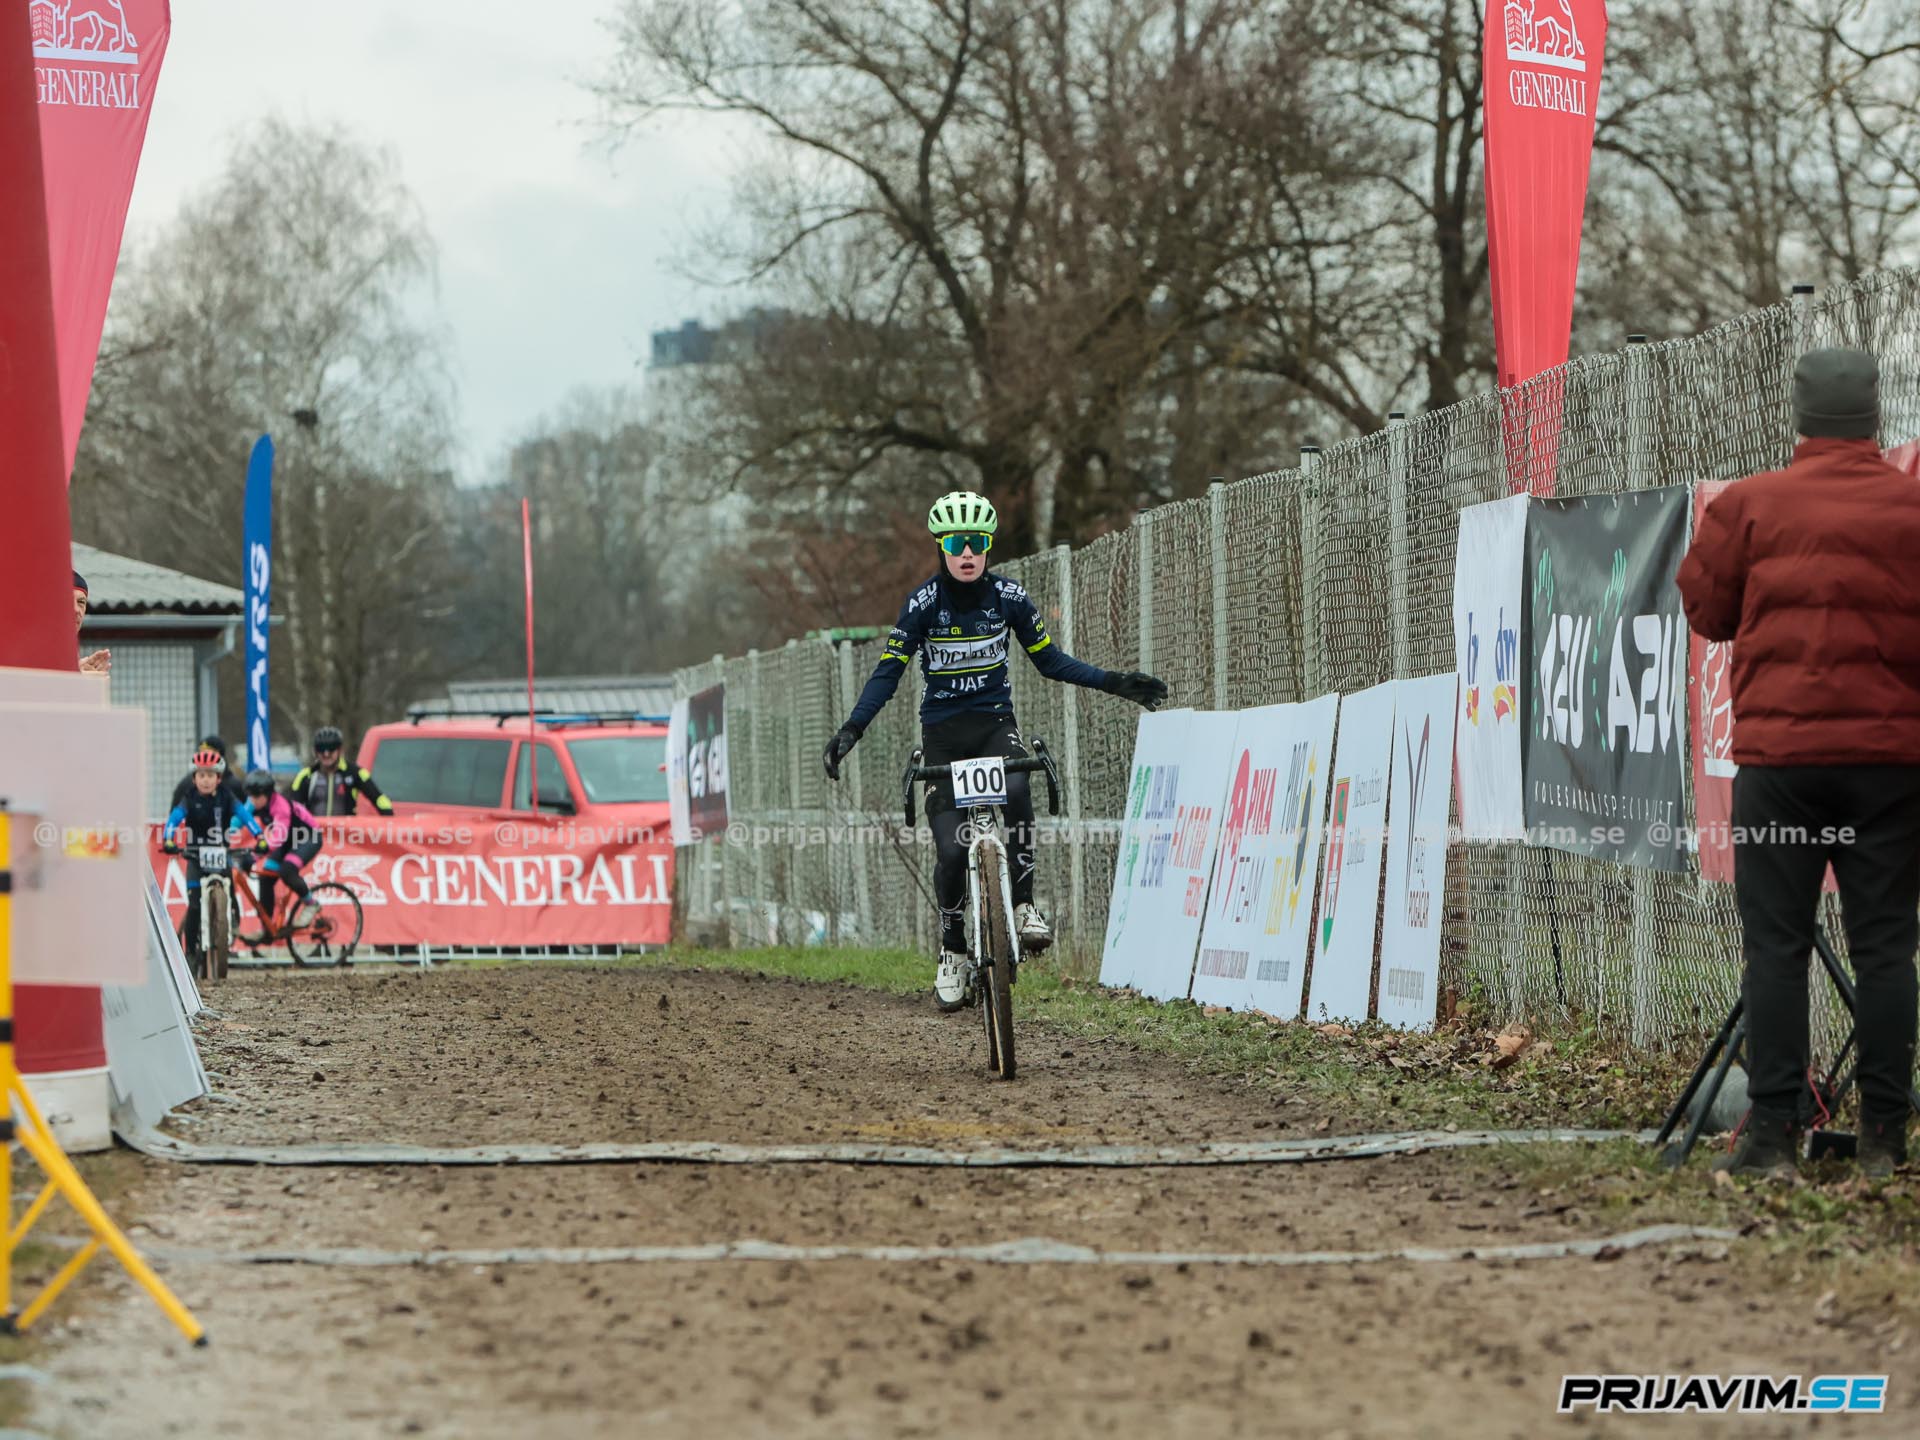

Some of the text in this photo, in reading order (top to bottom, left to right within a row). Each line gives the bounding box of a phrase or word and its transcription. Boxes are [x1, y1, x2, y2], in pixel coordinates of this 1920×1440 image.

[34, 67, 140, 109] GENERALI
[1509, 69, 1587, 116] GENERALI
[908, 581, 938, 613] A2U
[994, 580, 1027, 597] A2U
[1000, 592, 1025, 603] BIKES
[251, 541, 270, 772] DARS
[1540, 613, 1593, 749] A2U
[1607, 613, 1681, 755] A2U
[957, 767, 1004, 795] 100
[1245, 767, 1277, 835] PIKA
[390, 853, 672, 906] GENERALI
[1231, 856, 1266, 922] TEAM
